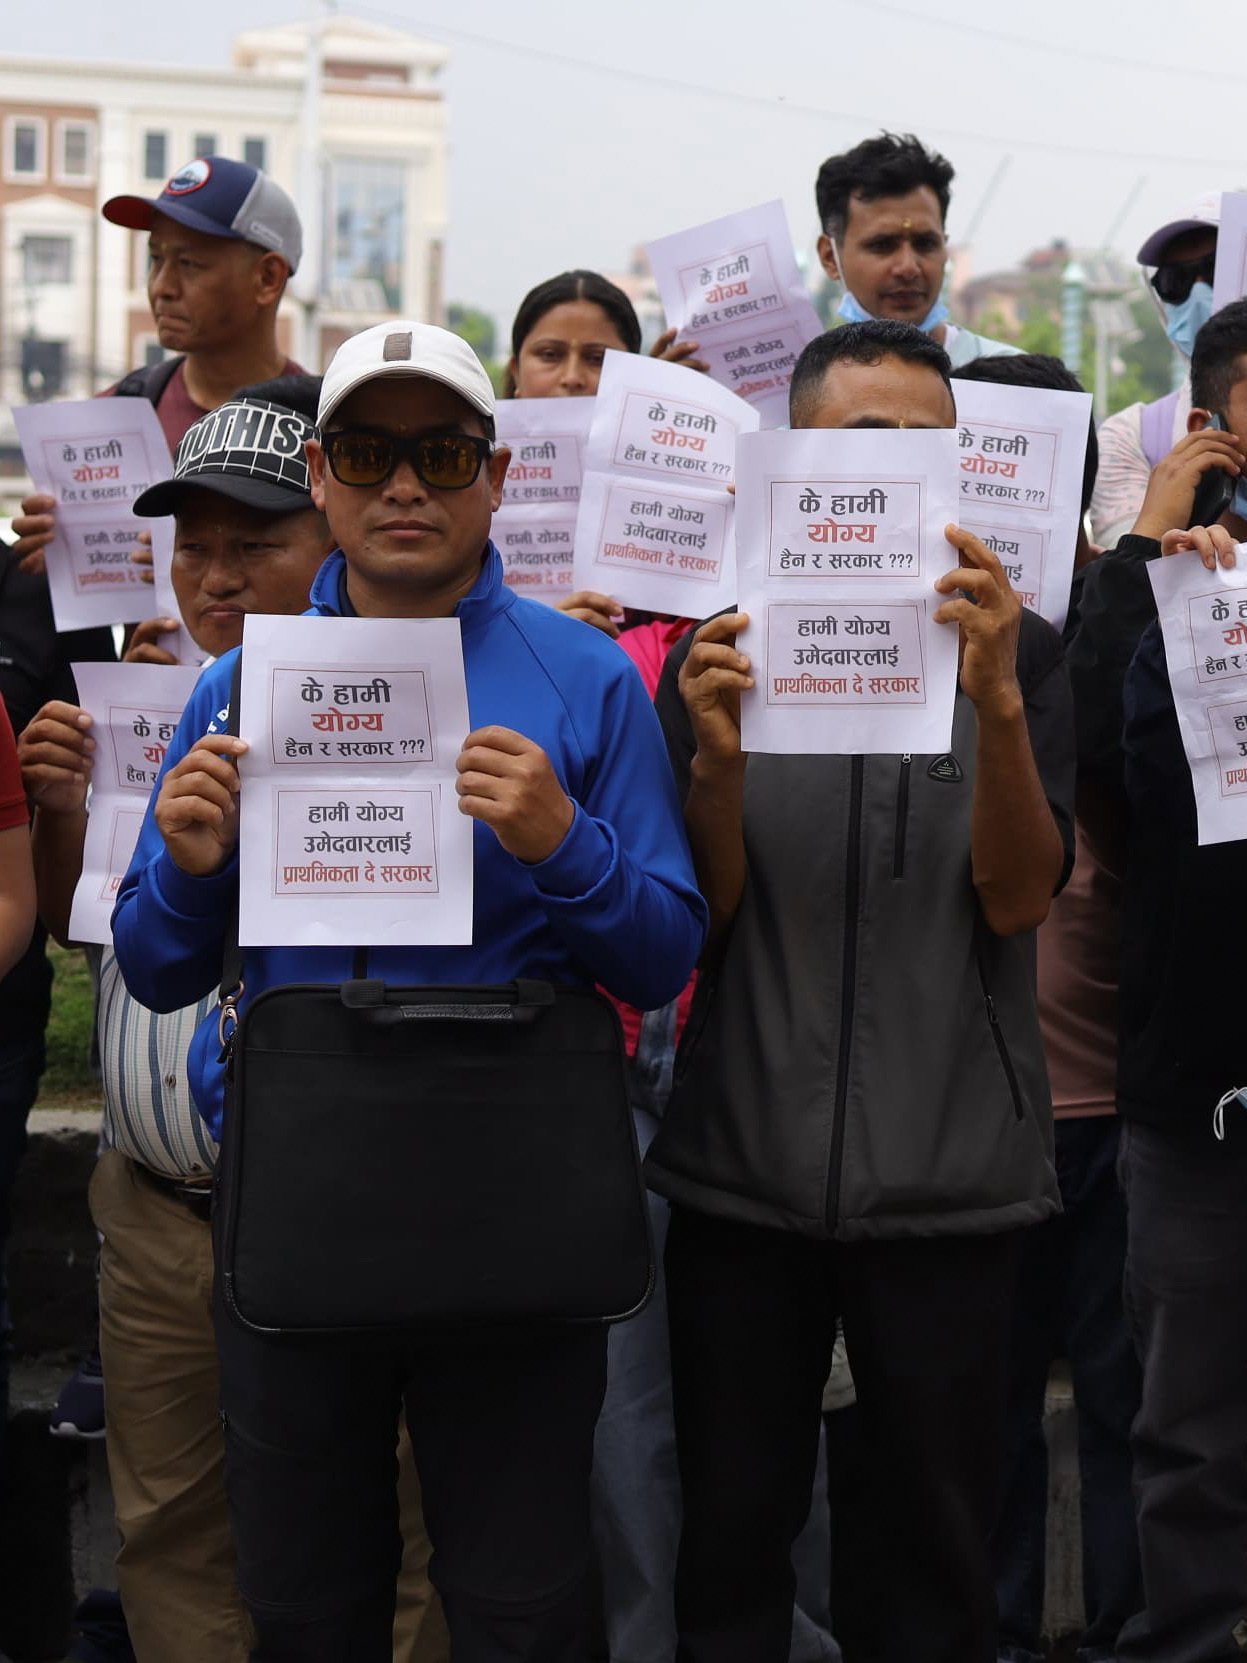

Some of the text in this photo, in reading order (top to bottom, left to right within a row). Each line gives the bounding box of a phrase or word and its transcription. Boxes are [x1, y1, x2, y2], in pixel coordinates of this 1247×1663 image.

[648, 402, 717, 434] के हामी
[651, 427, 708, 452] योग्य
[981, 435, 1029, 456] हामी
[624, 445, 731, 476] हैन र सरकार ???
[960, 453, 1019, 479] योग्य
[799, 488, 888, 515] के हामी
[961, 481, 1045, 503] र सरकार ???
[631, 499, 705, 524] हामी योग्य
[623, 521, 707, 550] उमेदवारलाई
[807, 518, 877, 544] योग्य
[603, 543, 718, 574] प्राथमिकता दे सरकार
[780, 549, 913, 569] हैन र सरकार ???
[1211, 598, 1230, 622] के
[797, 616, 890, 637] हामी योग्य
[793, 644, 900, 667] उमेदवारलाई
[1205, 656, 1228, 675] हैन
[1232, 654, 1242, 669] र
[301, 677, 391, 705] के हामी
[773, 673, 920, 695] प्राथमिकता दे सरकार
[133, 715, 151, 737] के
[312, 707, 384, 732] योग्य
[285, 737, 425, 757] हैन र सरकार ???
[127, 764, 146, 783] हैन
[308, 801, 404, 823] हामी योग्य
[304, 831, 412, 854] उमेदवारलाई
[283, 861, 432, 884] प्राथमिकता दे सरकार
